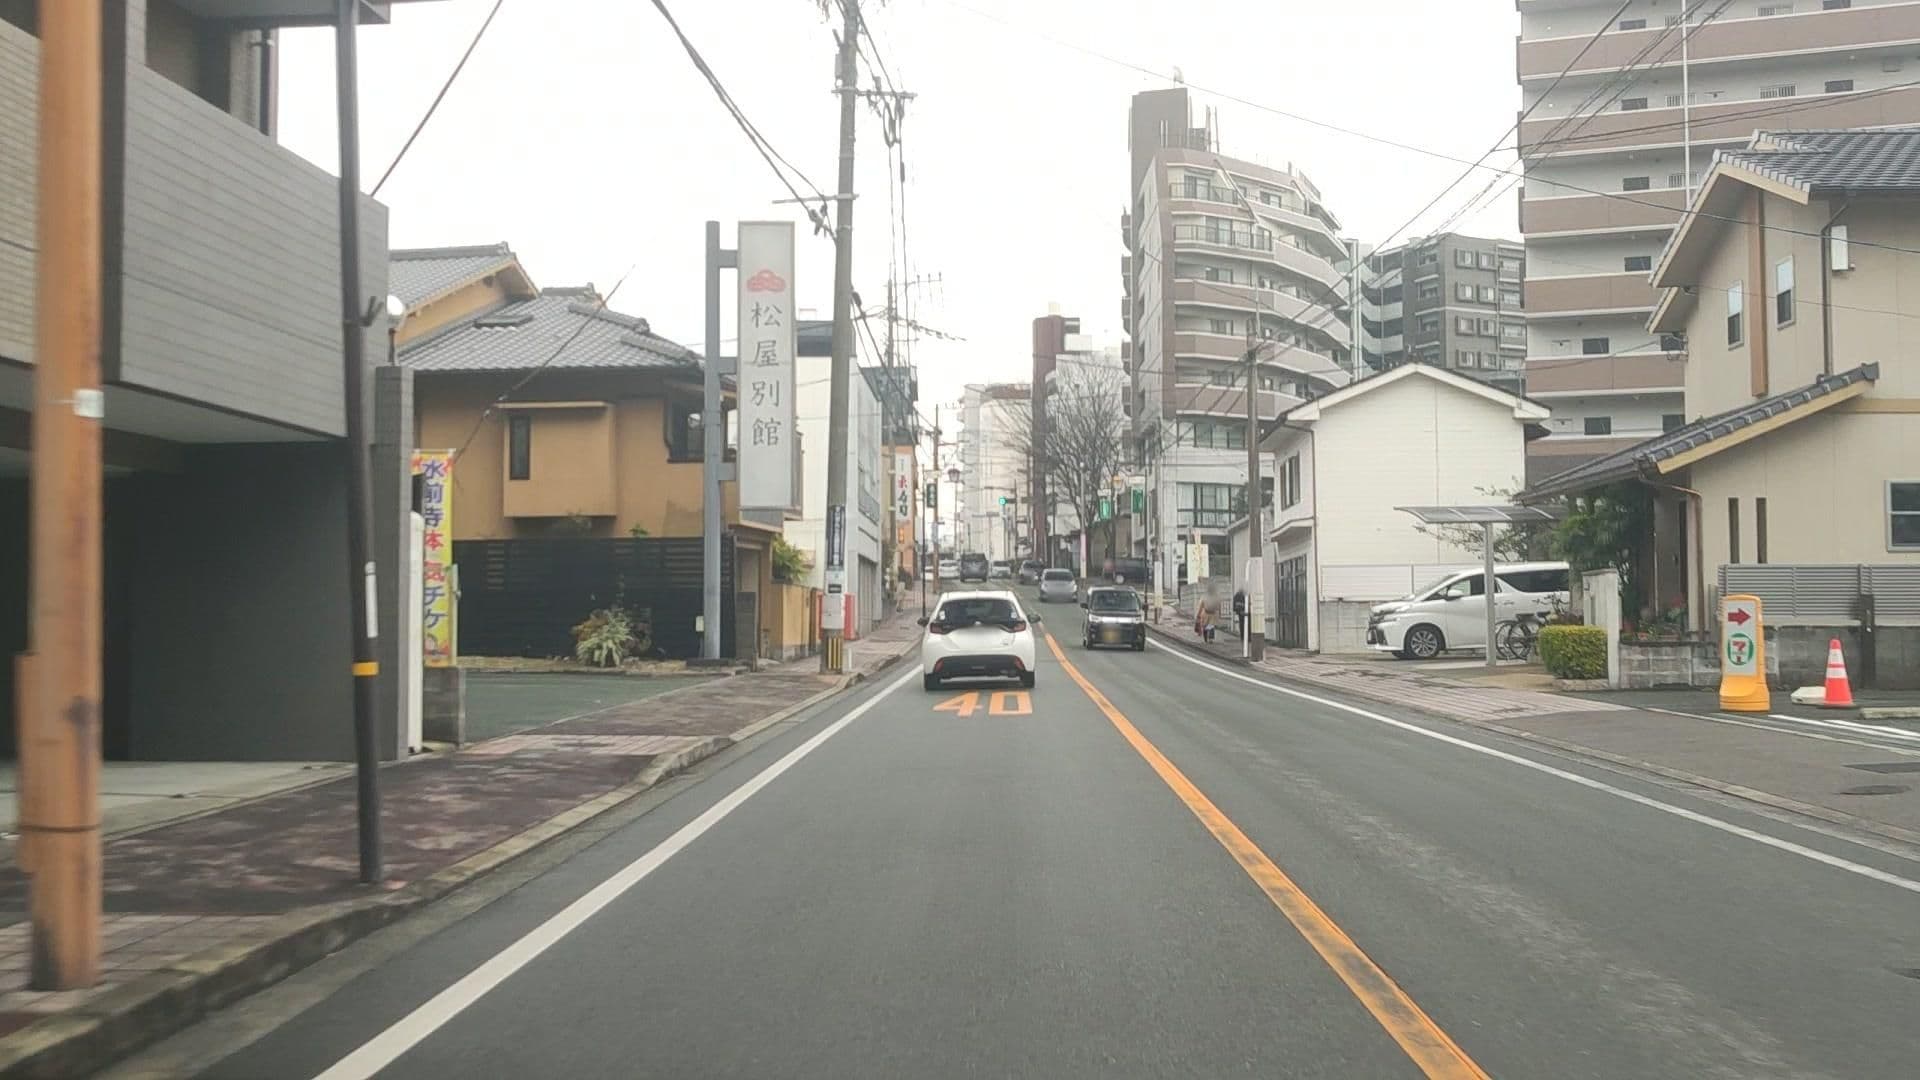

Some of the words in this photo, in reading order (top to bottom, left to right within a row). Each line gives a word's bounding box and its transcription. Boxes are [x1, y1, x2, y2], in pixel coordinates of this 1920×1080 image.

[751, 302, 782, 446] 松屋別館
[932, 691, 1033, 716] 40
